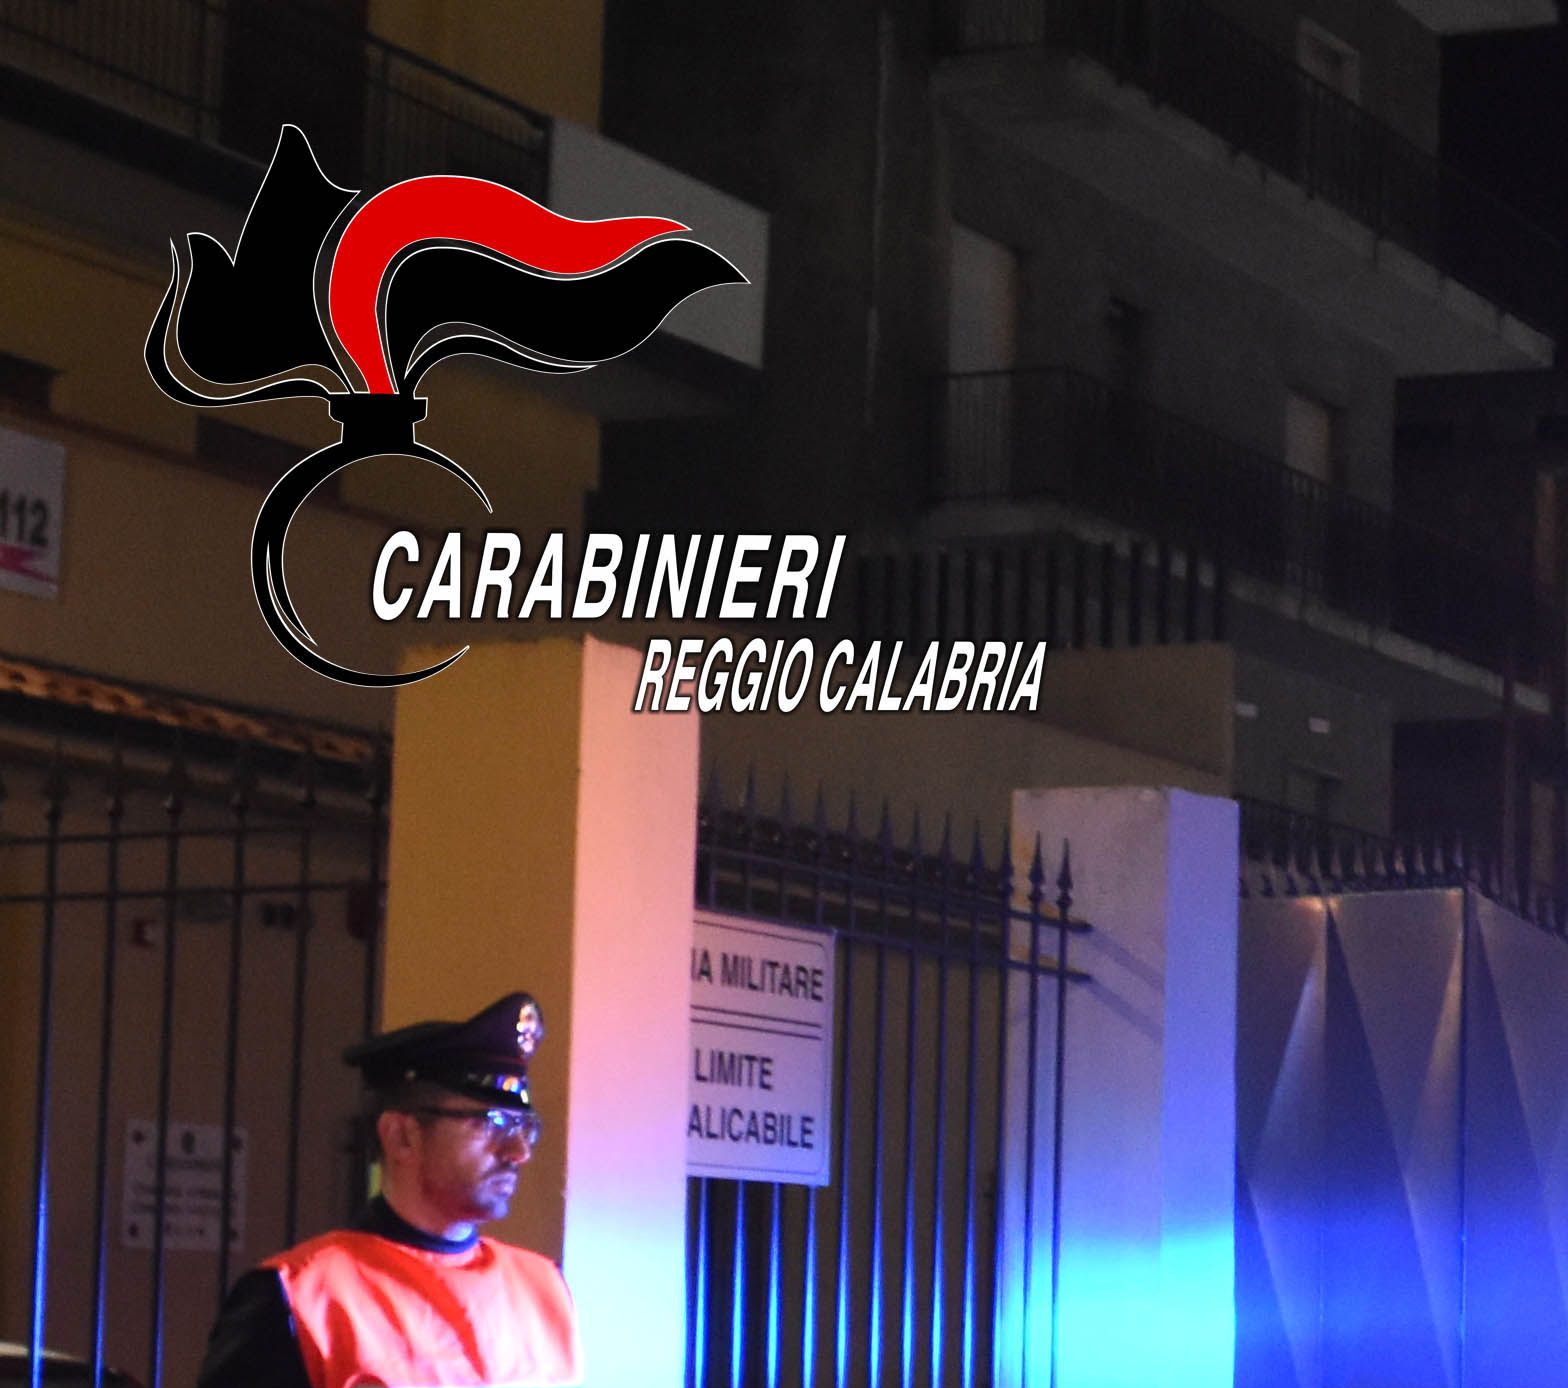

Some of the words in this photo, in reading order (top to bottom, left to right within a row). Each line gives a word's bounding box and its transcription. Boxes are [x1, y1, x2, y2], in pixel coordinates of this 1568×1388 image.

[721, 952, 824, 1002] MILITARE
[694, 1048, 774, 1090] LIMITE
[687, 1104, 815, 1150] ALICABILE
